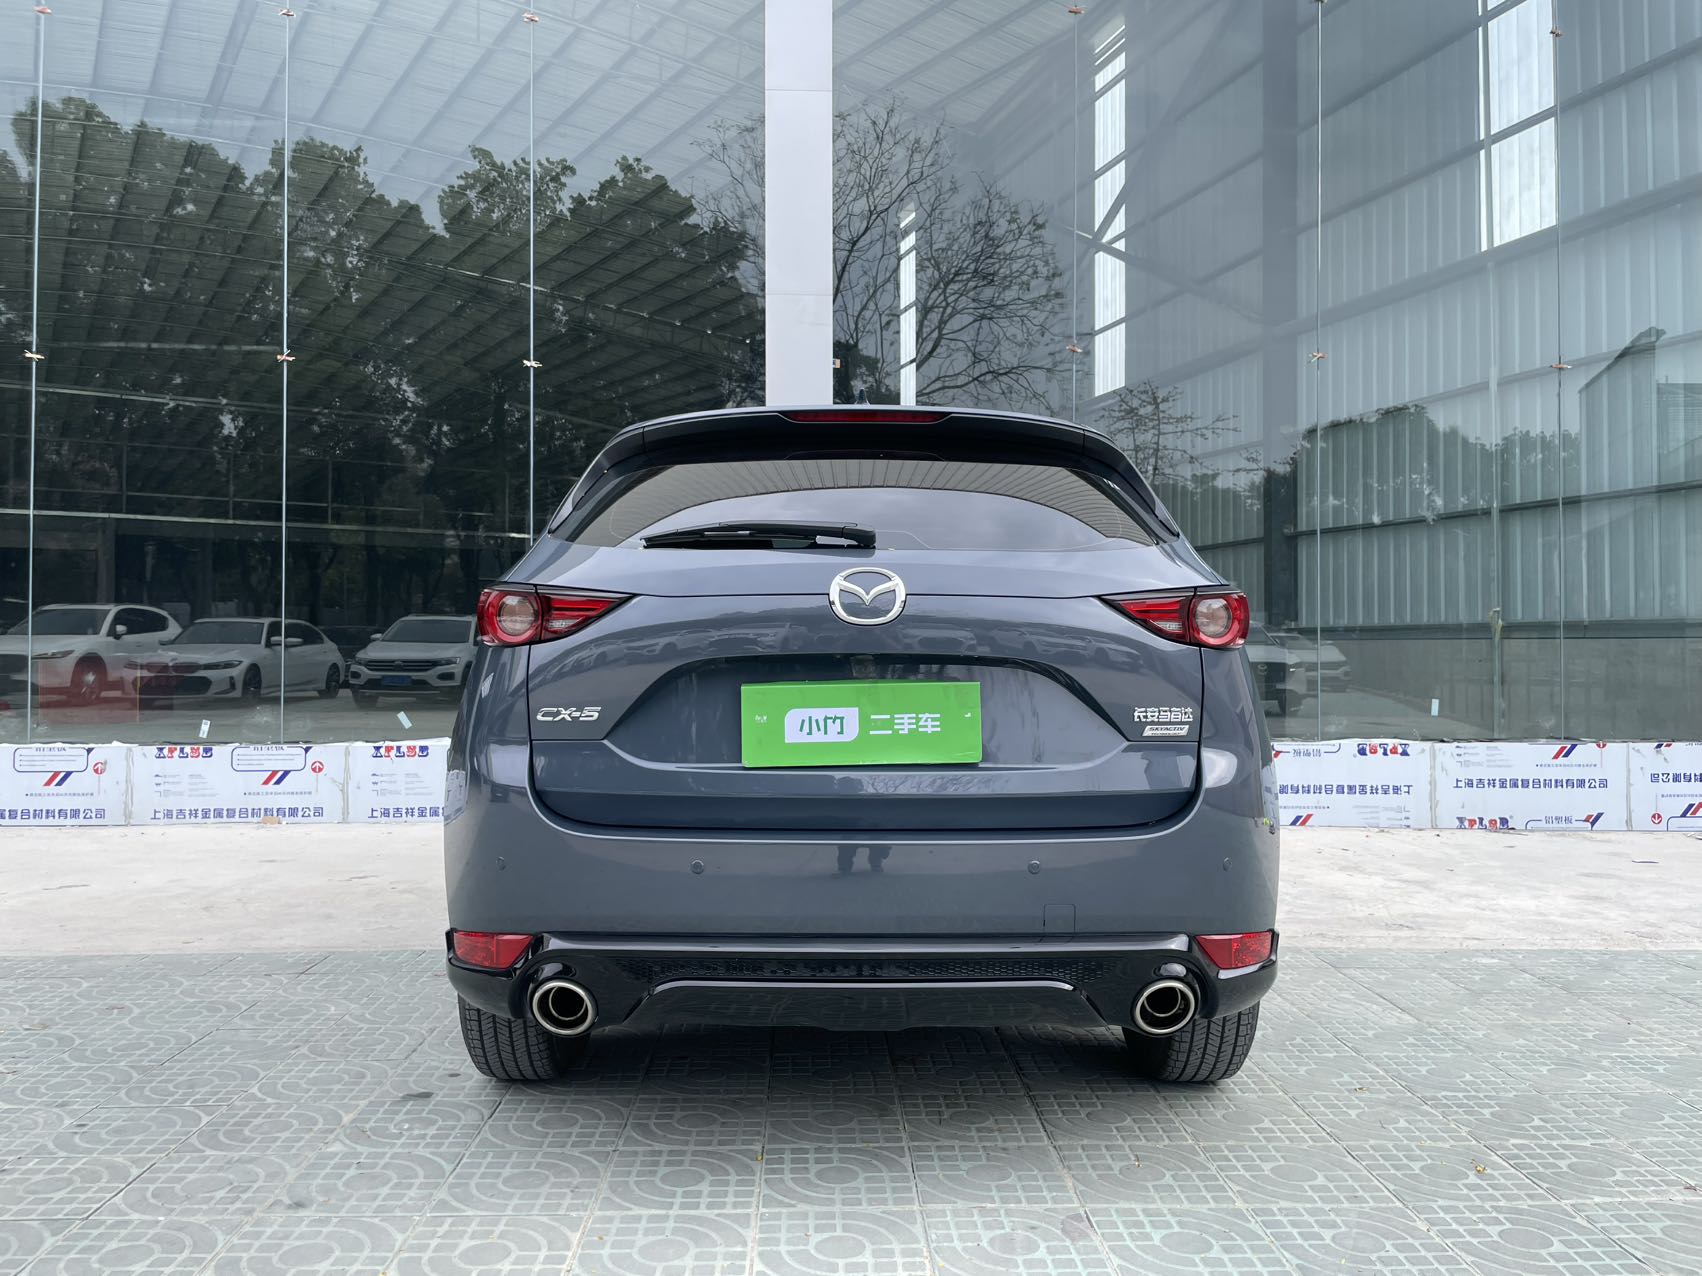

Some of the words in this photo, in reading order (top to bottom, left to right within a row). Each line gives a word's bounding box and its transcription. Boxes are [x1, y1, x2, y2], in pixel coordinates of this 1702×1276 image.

[536, 706, 602, 722] CX-5
[1133, 707, 1194, 722] 长安马自达
[798, 714, 846, 736] 小竹
[869, 712, 942, 735] 二手车
[1453, 778, 1608, 789] 上海吉祥金属复合材料有限公司
[150, 806, 324, 820] 上海吉祥金属复合材料有限公司
[368, 806, 444, 819] 上海吉祥金属
